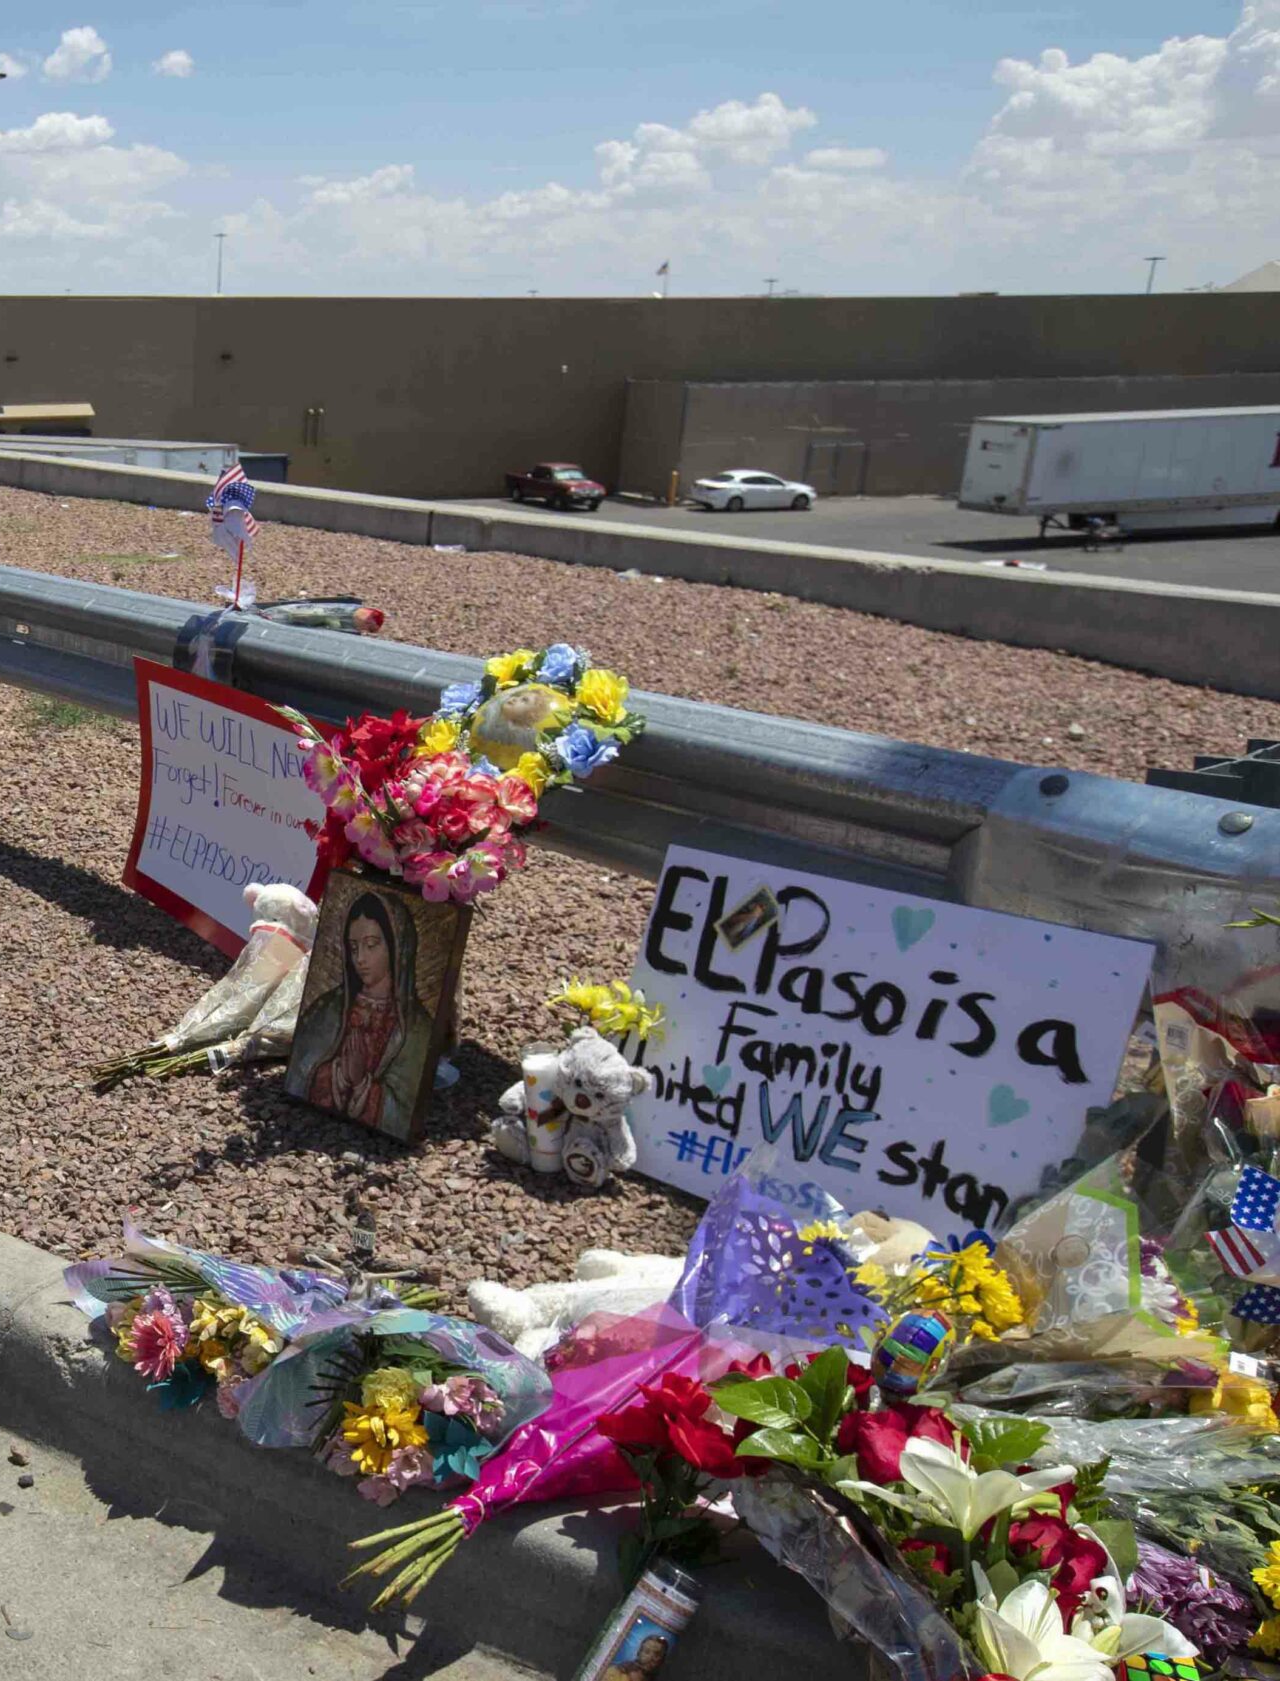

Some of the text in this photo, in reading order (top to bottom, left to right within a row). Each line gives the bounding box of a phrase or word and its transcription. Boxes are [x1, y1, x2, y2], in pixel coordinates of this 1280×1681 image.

[152, 746, 220, 808] Forget!
[223, 773, 267, 818] Forever
[271, 809, 282, 824] in
[155, 692, 307, 780] WE WILL NEV
[645, 865, 1090, 1085] EL Paso is a
[715, 1000, 882, 1113] Family
[759, 1080, 880, 1173] WE
[876, 1139, 1009, 1229] stan
